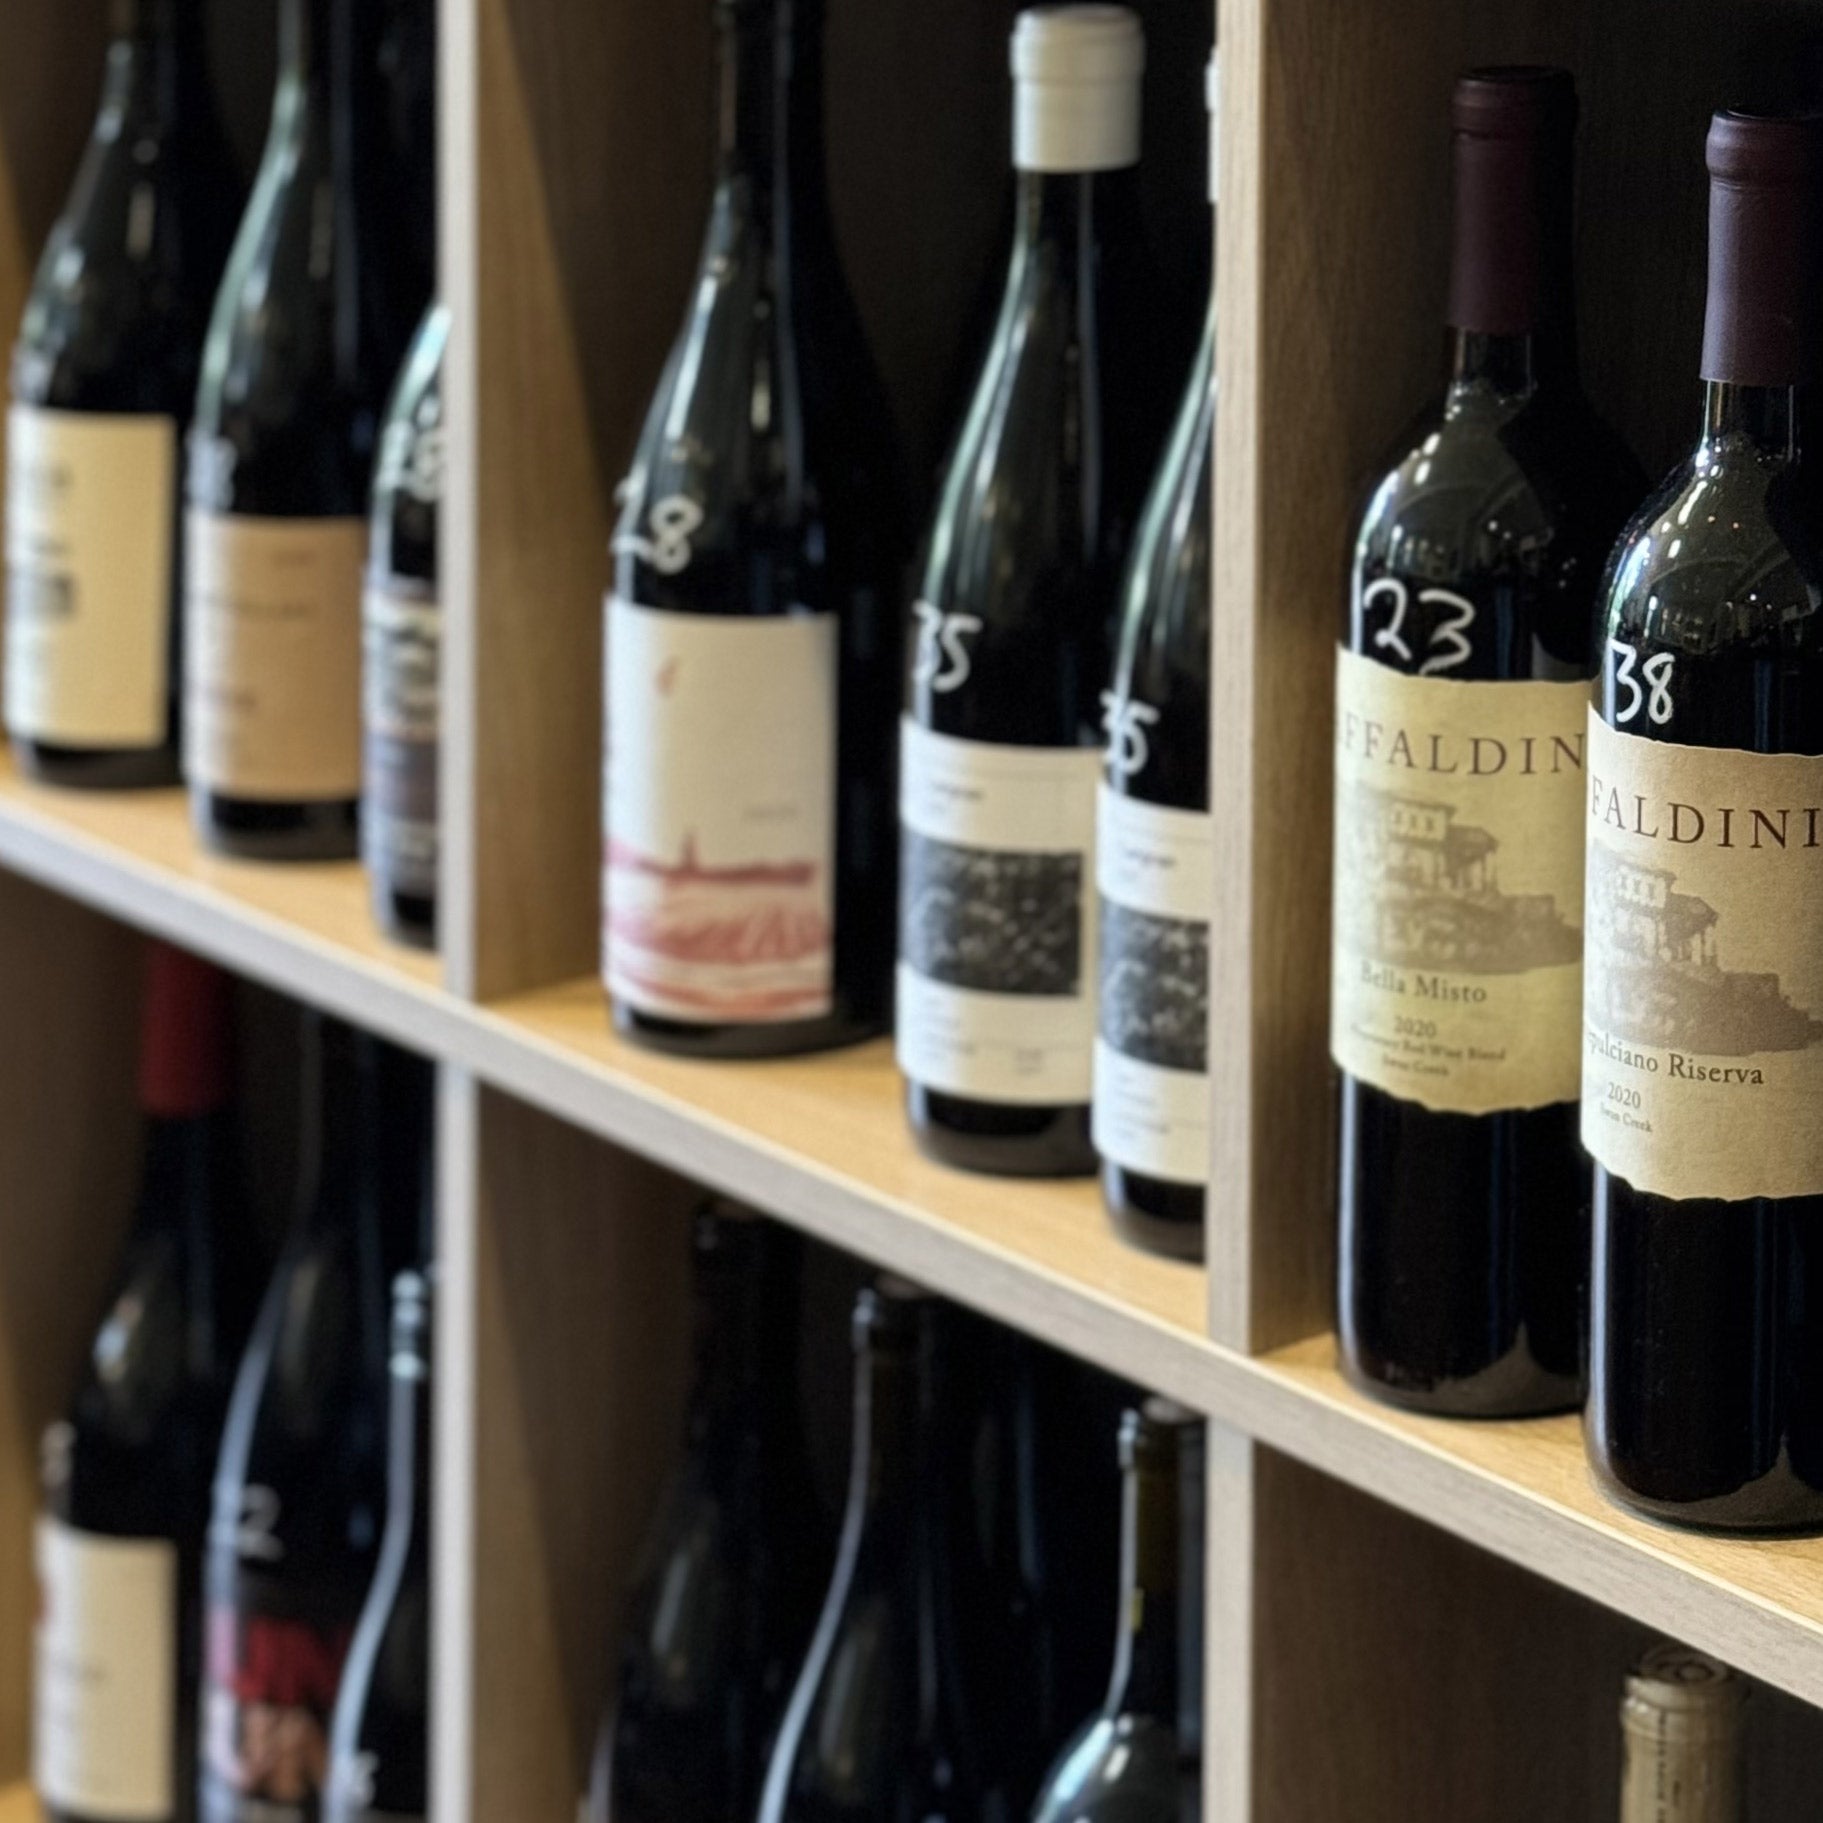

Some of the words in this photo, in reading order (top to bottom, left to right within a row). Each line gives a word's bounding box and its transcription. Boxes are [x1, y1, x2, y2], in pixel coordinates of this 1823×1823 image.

[1363, 577, 1475, 676] 23
[1607, 637, 1676, 724] 38
[1591, 775, 1822, 849] FALDINI
[1360, 959, 1407, 995] Bella
[1414, 974, 1488, 1003] Misto
[1394, 1015, 1438, 1039] 2020
[1668, 1053, 1764, 1085] Riserva
[1607, 1082, 1642, 1109] 2020
